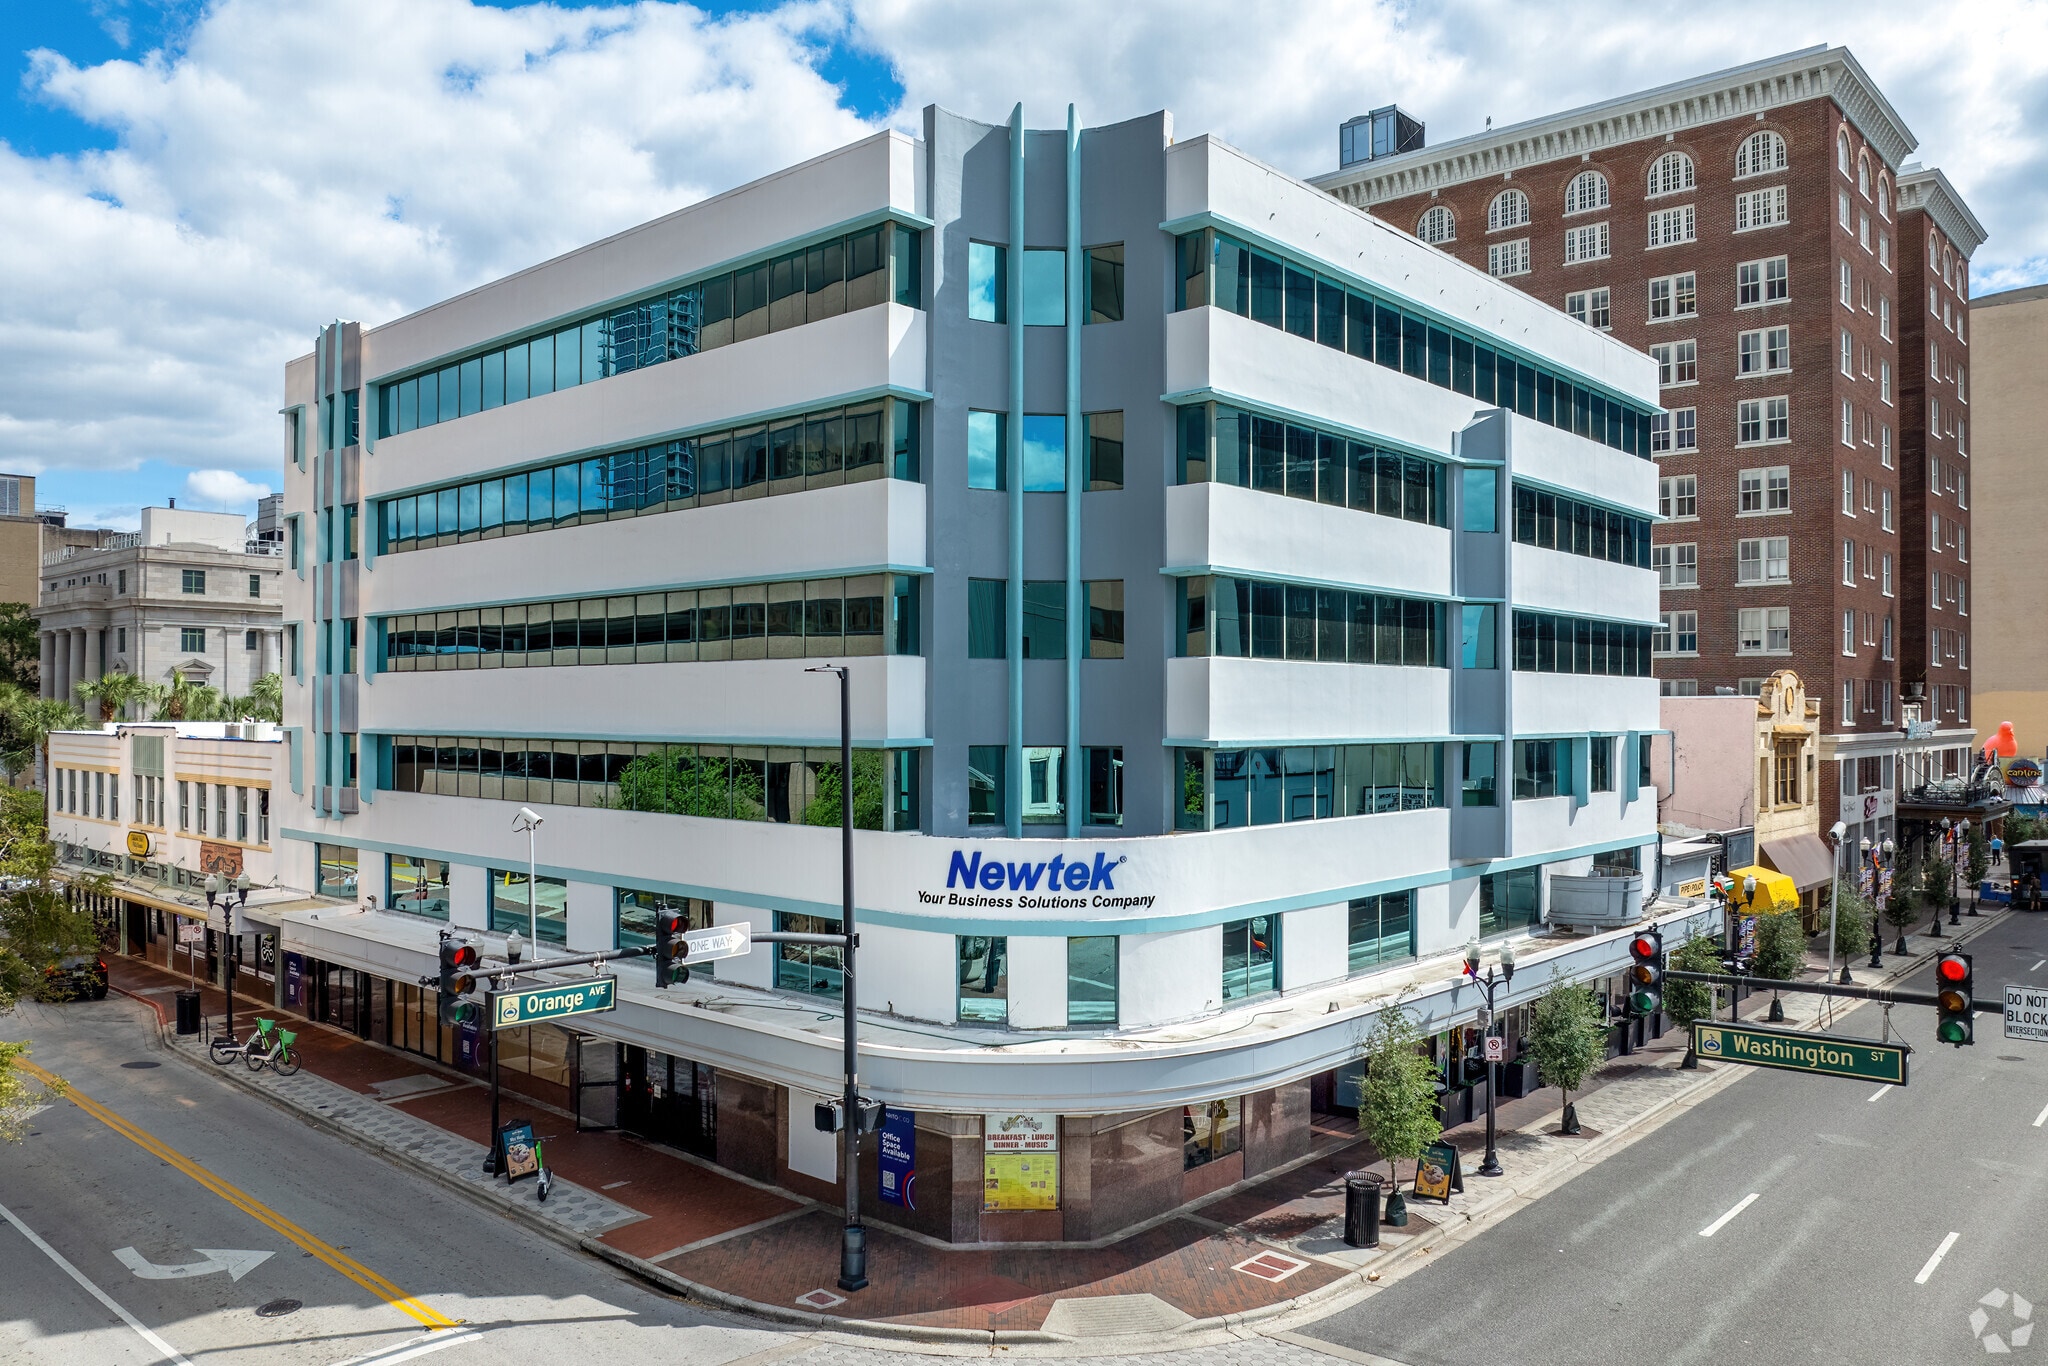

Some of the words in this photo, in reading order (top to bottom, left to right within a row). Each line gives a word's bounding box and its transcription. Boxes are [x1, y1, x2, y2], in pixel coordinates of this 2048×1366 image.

[918, 891, 946, 905] Your
[948, 893, 1013, 908] Business
[1018, 895, 1087, 909] Solutions
[1092, 894, 1155, 911] Company
[690, 940, 709, 953] ONE
[712, 936, 731, 949] WAY
[526, 992, 584, 1014] Orange
[589, 985, 606, 997] AVE
[2007, 993, 2022, 1006] DO
[2026, 995, 2048, 1009] NOT
[2007, 1010, 2048, 1026] BLOCK
[2007, 1025, 2048, 1037] INTERSECTION
[1733, 1034, 1854, 1068] Washington
[1870, 1051, 1885, 1062] ST
[882, 1132, 901, 1143] Office
[882, 1139, 901, 1150] Space
[882, 1146, 910, 1160] Available
